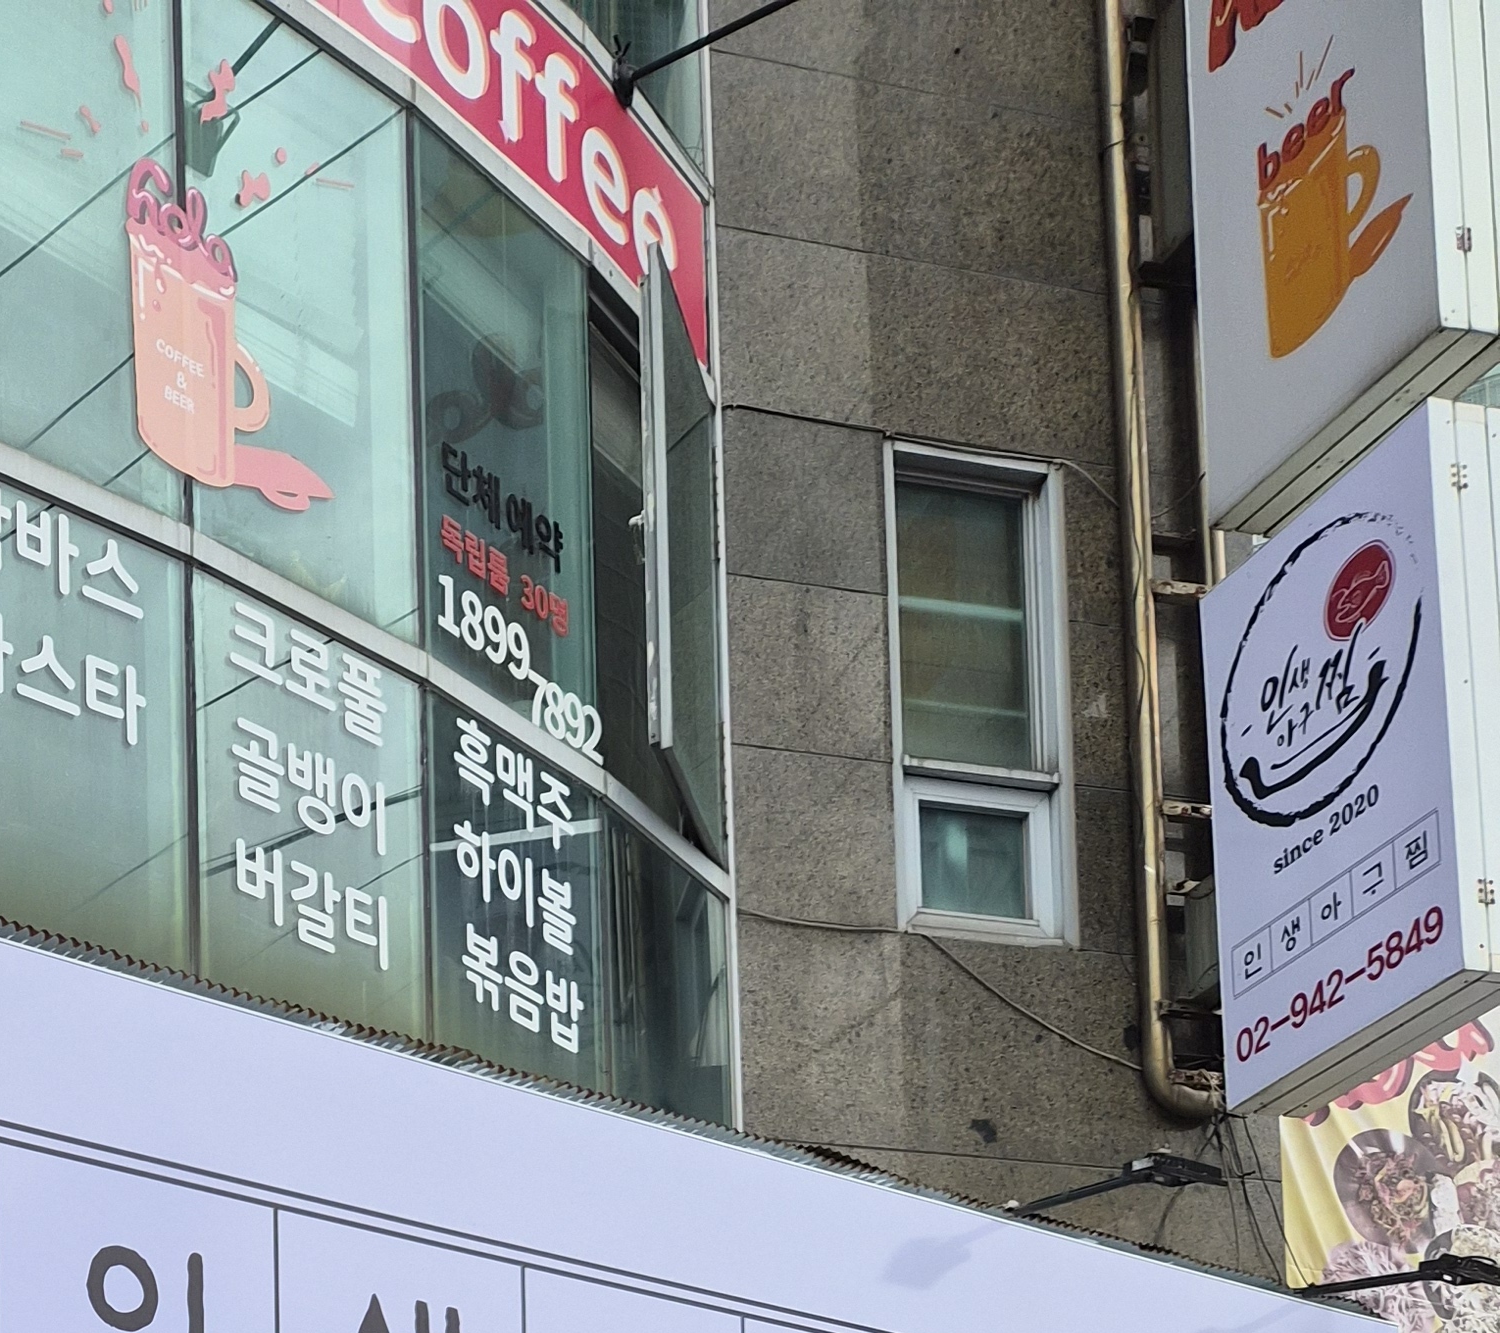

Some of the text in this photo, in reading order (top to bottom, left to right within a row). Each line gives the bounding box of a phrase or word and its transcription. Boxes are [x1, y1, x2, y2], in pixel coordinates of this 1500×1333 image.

[1257, 68, 1355, 191] beer
[156, 338, 204, 378] COFFEE
[164, 385, 195, 414] BEER
[176, 371, 187, 389] &
[437, 574, 531, 680] 1899
[441, 514, 569, 637] 독립룸 30명
[528, 668, 604, 766] 7892
[232, 717, 387, 856] 골뱅이
[453, 717, 574, 850] 흑맥주
[1272, 784, 1380, 874] since 2020
[236, 838, 389, 971] 버갈티
[453, 820, 577, 955] 하이볼
[462, 923, 585, 1054] 볶음밥
[1237, 905, 1445, 1065] 02-942-5849
